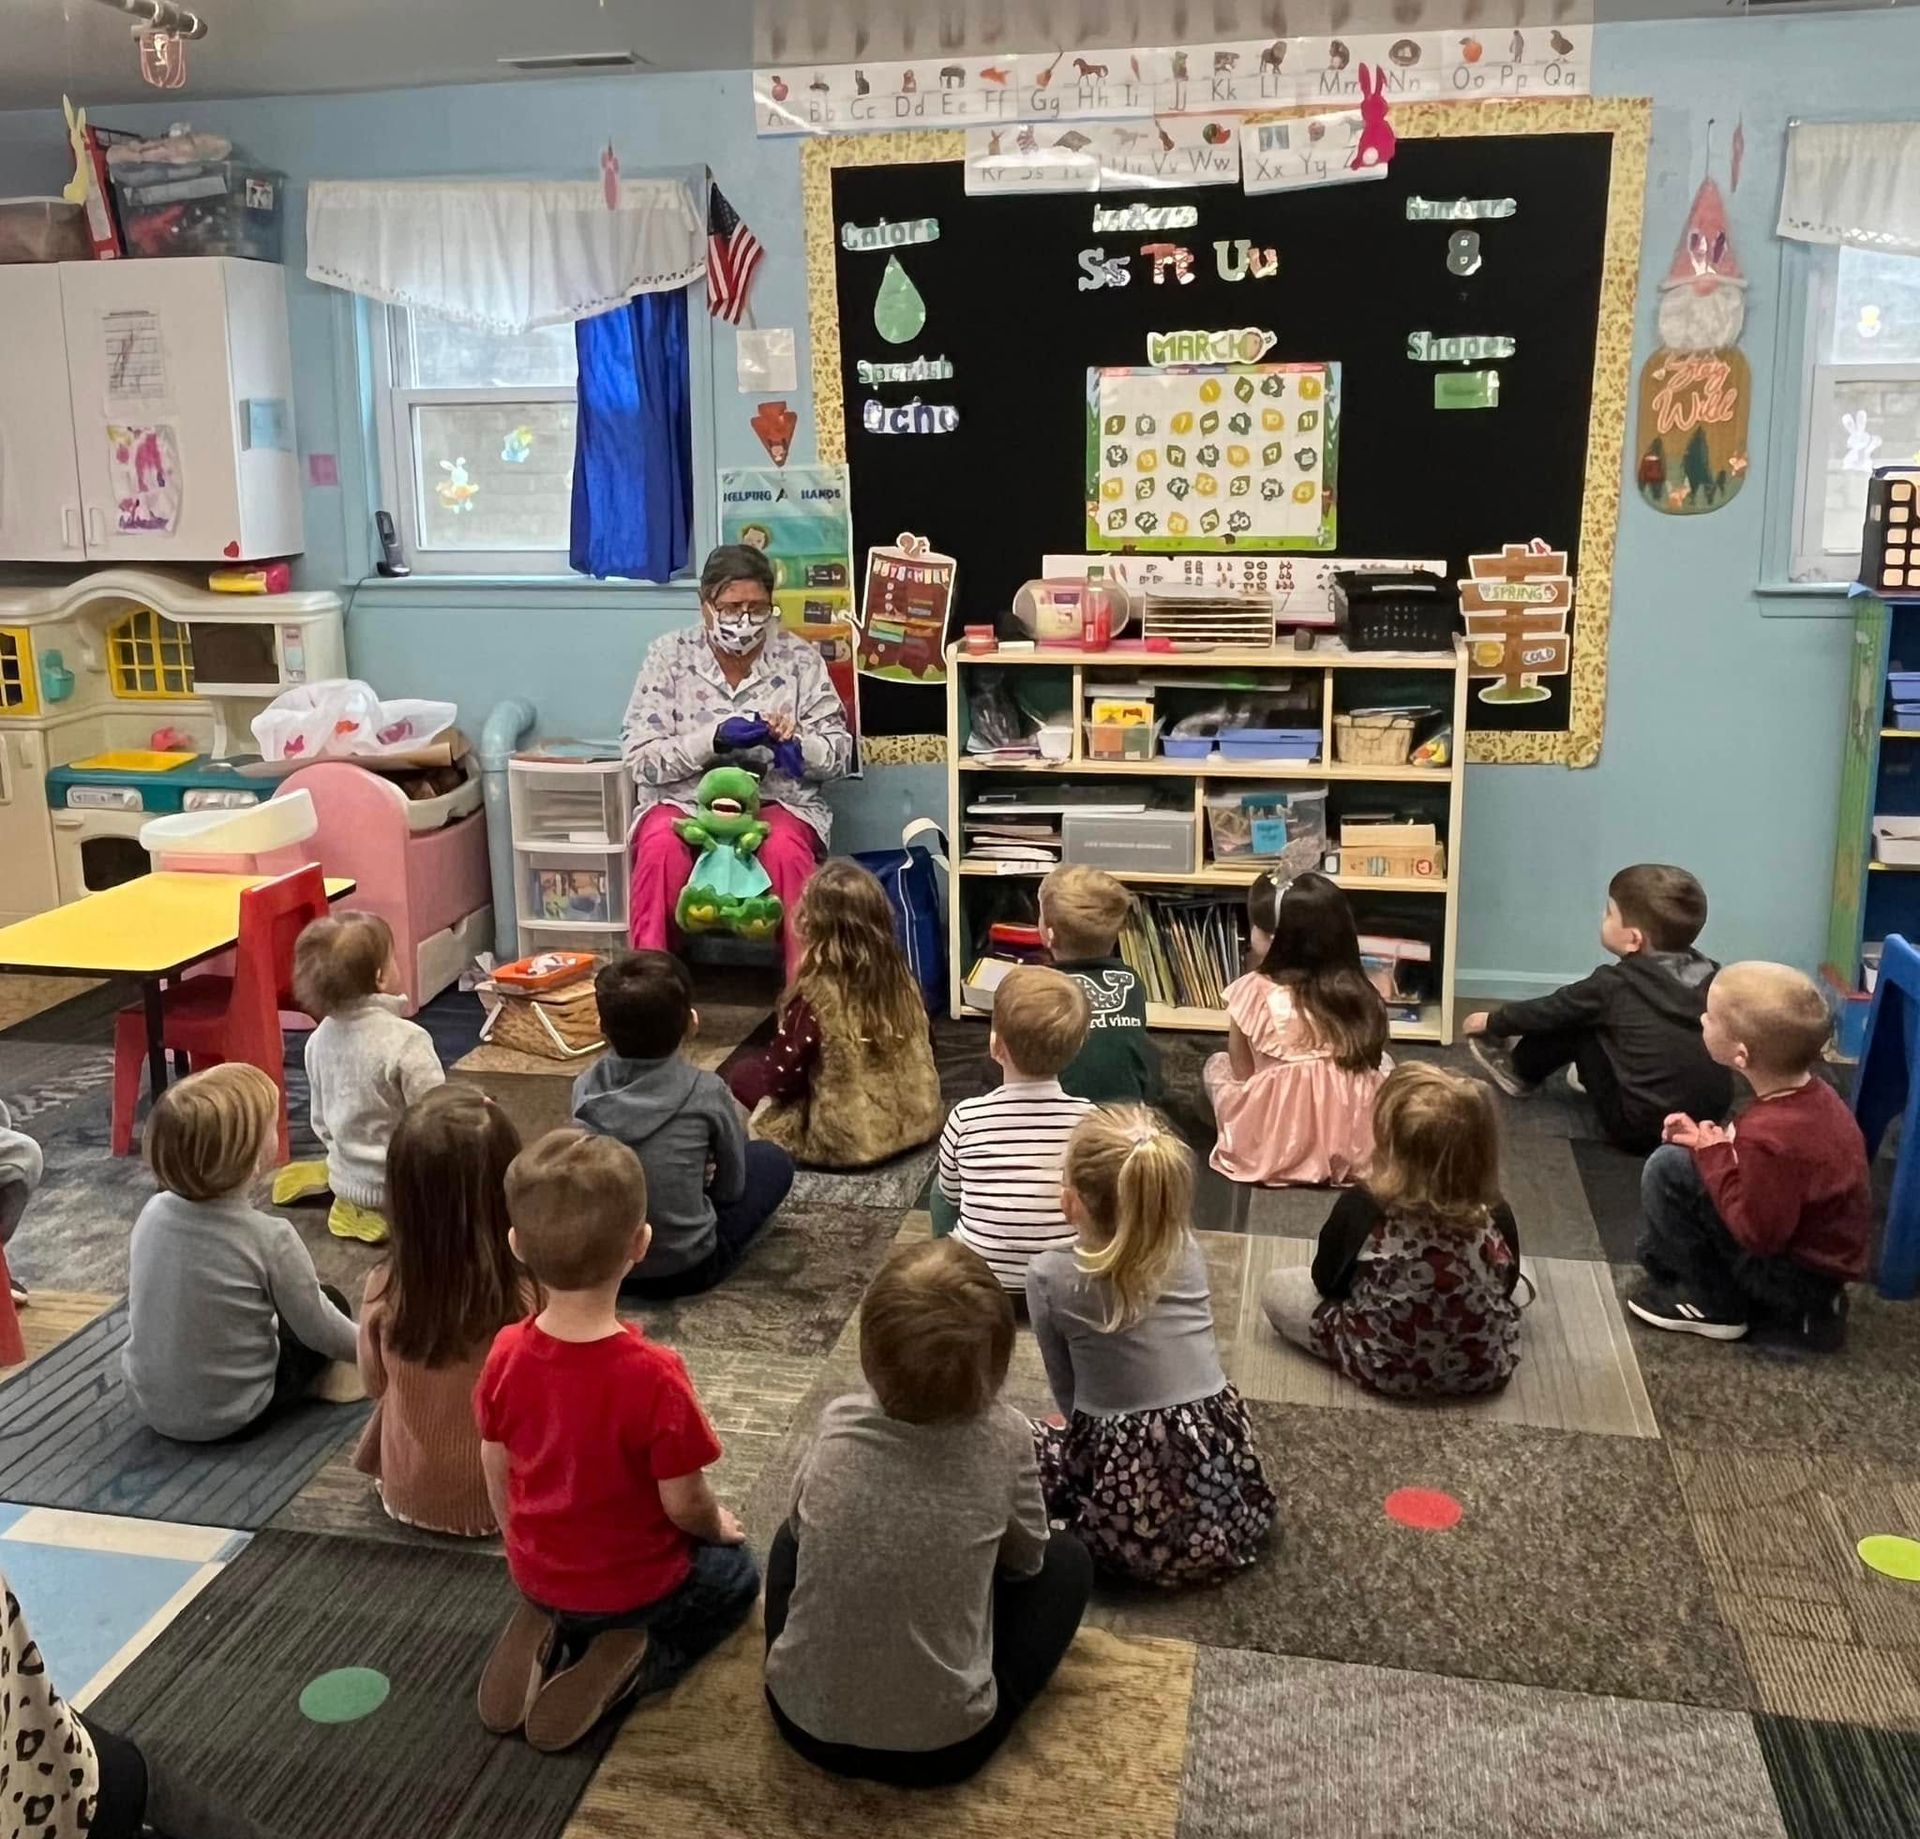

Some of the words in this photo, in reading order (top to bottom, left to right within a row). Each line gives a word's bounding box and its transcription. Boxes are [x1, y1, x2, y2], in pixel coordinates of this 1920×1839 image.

[811, 101, 834, 122] Bb
[851, 98, 877, 119] Cc
[896, 93, 925, 117] Dd
[942, 92, 968, 114] Ee
[1031, 89, 1060, 118] Gg
[1078, 87, 1109, 109] Hh
[1212, 78, 1238, 101] Kk
[1387, 70, 1420, 93] Nn
[1453, 66, 1485, 90] Oo
[1501, 64, 1527, 93] Pp
[1544, 62, 1576, 89] Qq
[1152, 151, 1178, 174] Vv
[1188, 149, 1231, 173] Ww
[1256, 158, 1284, 181] Xx
[1299, 151, 1327, 180] Yy
[1446, 229, 1481, 276] 8
[1078, 247, 1131, 292] Ss
[1140, 243, 1196, 285] Tt
[1213, 239, 1278, 282] Uu
[1151, 332, 1249, 364] MARCH
[1110, 448, 1122, 462] 12
[801, 488, 842, 501] HANDS
[1138, 480, 1152, 499] 20
[1231, 480, 1248, 494] 23
[1491, 584, 1543, 600] SPRING
[1522, 647, 1555, 664] COLD
